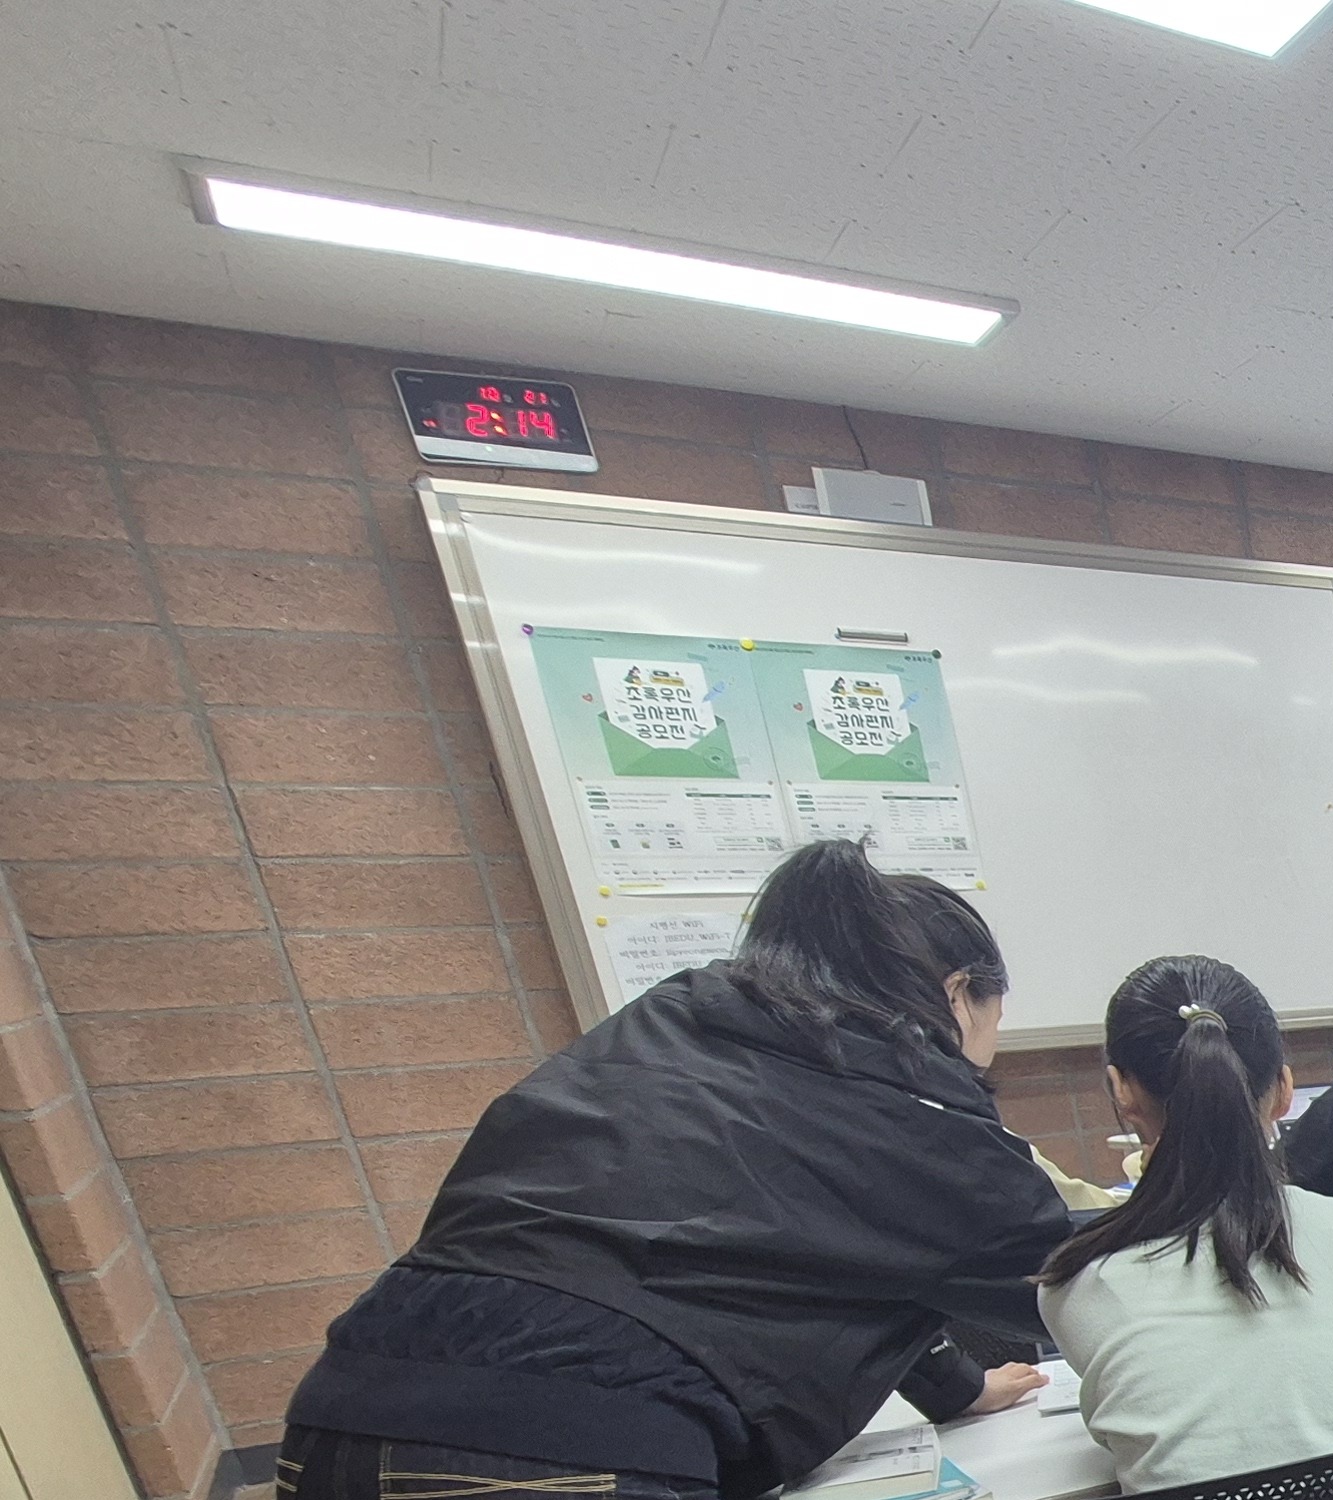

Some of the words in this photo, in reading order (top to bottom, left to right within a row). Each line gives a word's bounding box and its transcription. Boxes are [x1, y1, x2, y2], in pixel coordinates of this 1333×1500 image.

[465, 403, 557, 440] 2:14
[626, 686, 692, 704] 초록우산
[831, 695, 890, 712] 초록우산
[629, 704, 698, 722] 감사편지
[834, 712, 895, 730] 감사편지
[636, 723, 687, 741] 공모전
[838, 730, 884, 747] 공모전
